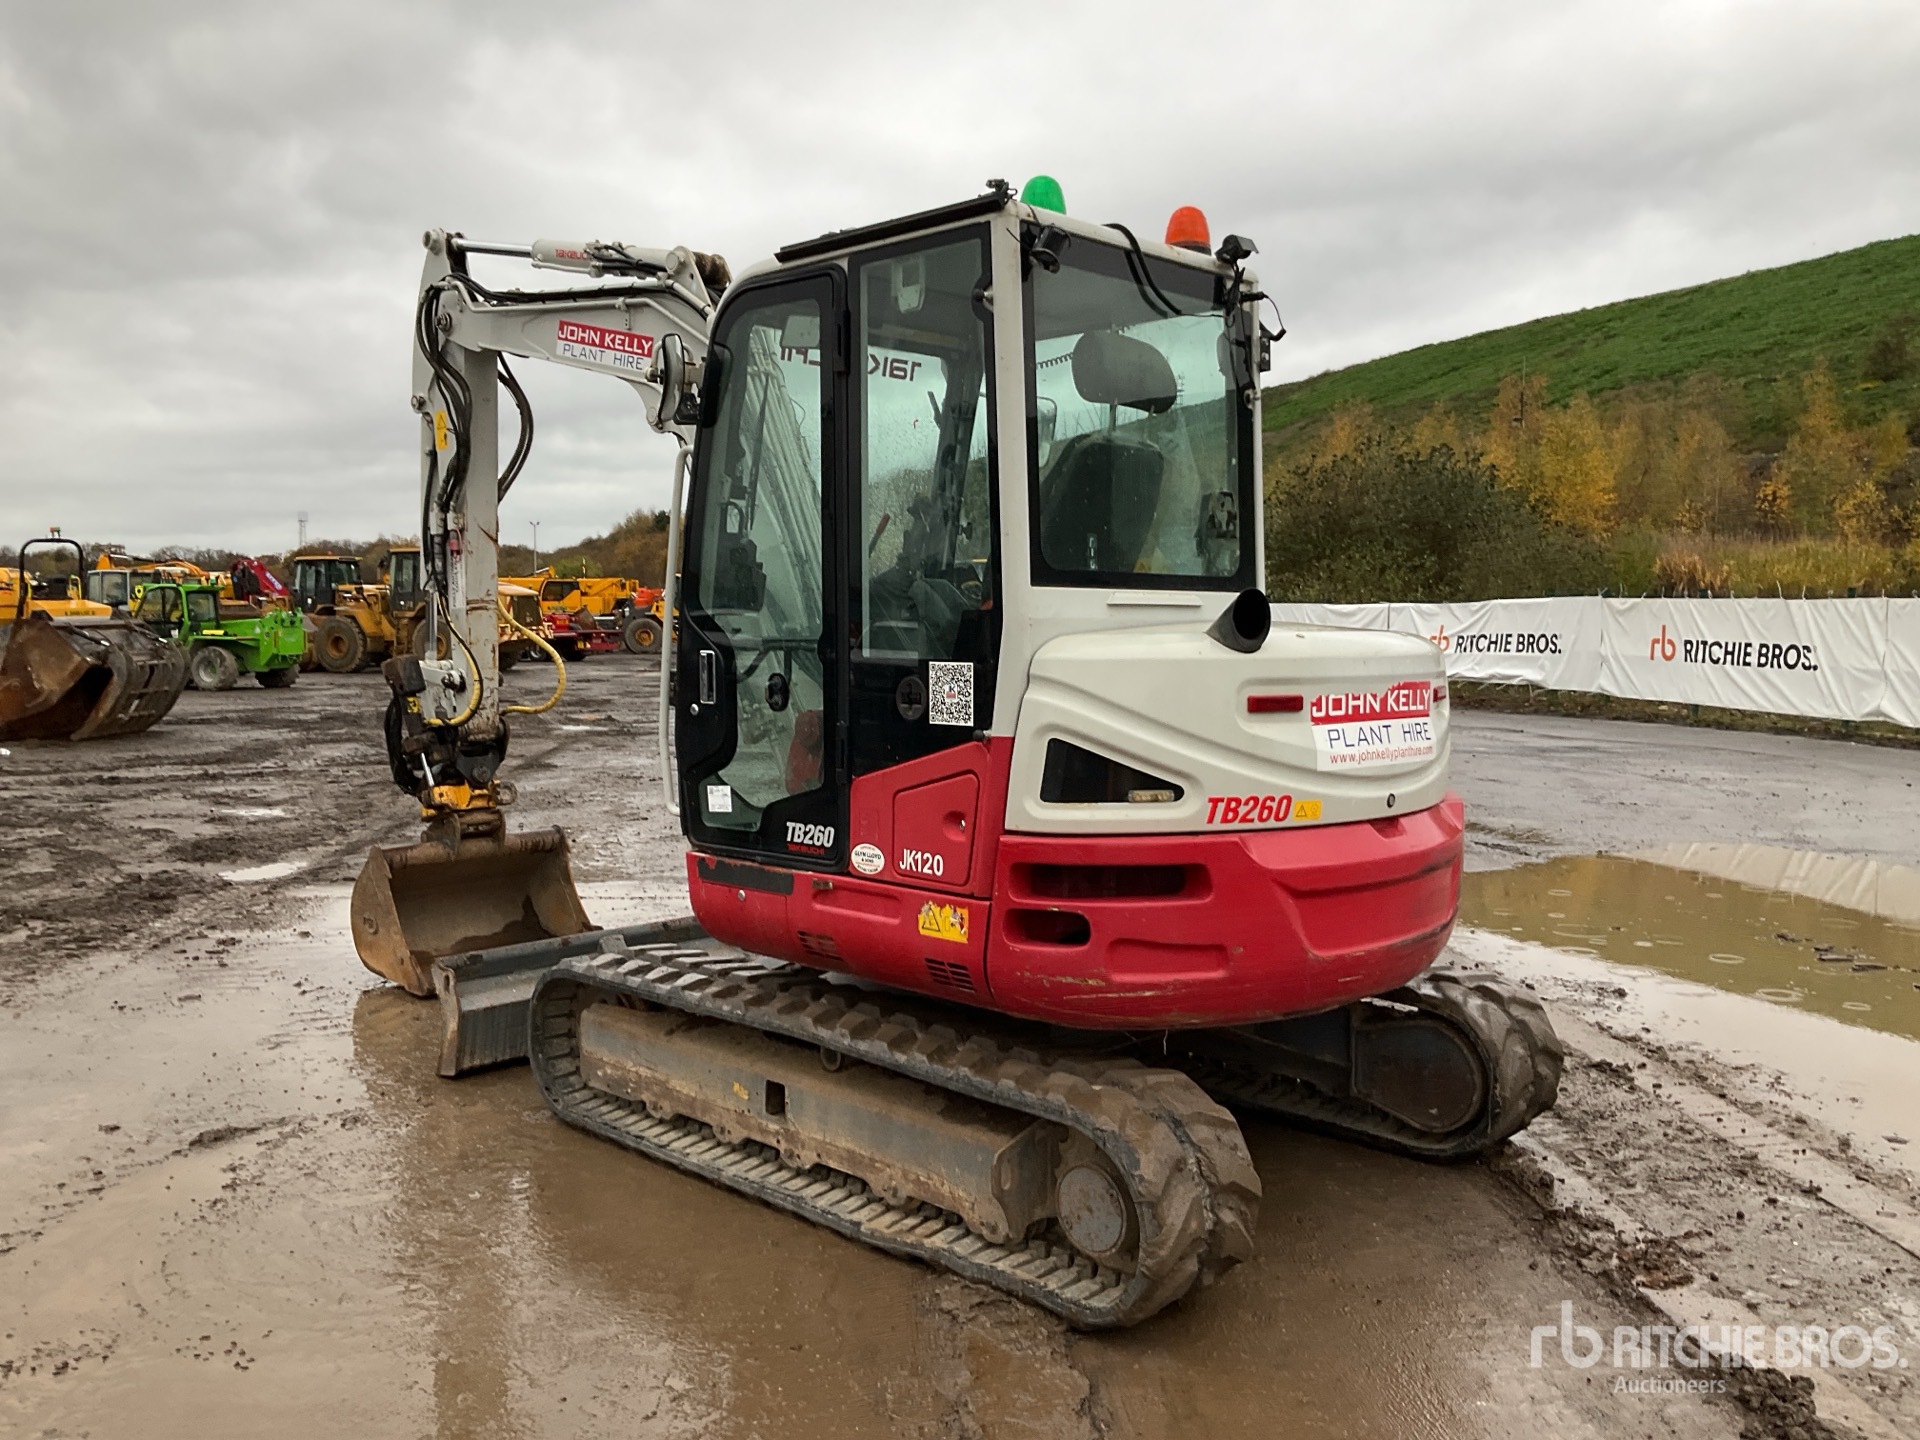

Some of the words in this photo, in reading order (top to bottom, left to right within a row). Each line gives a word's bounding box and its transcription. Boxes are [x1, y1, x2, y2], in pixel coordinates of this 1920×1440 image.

[558, 325, 600, 345] JOHN
[604, 332, 652, 354] KELLY
[562, 343, 605, 362] PLANT
[613, 352, 645, 370] HIRE
[1454, 633, 1513, 653] RITCHIE
[1515, 633, 1562, 654] BROS.
[1650, 624, 1676, 661] rb
[1684, 639, 1753, 667] RITCHIE
[1757, 643, 1819, 671] BROS.
[1312, 694, 1380, 717] JOHN
[1387, 688, 1430, 712] KELLY
[1327, 724, 1391, 749] PLANT
[1402, 722, 1431, 742] HIRE
[1329, 745, 1434, 764] www.johnkellyplanthire.com
[1206, 795, 1292, 824] TB260
[786, 821, 835, 848] TB260
[899, 848, 944, 876] JK120
